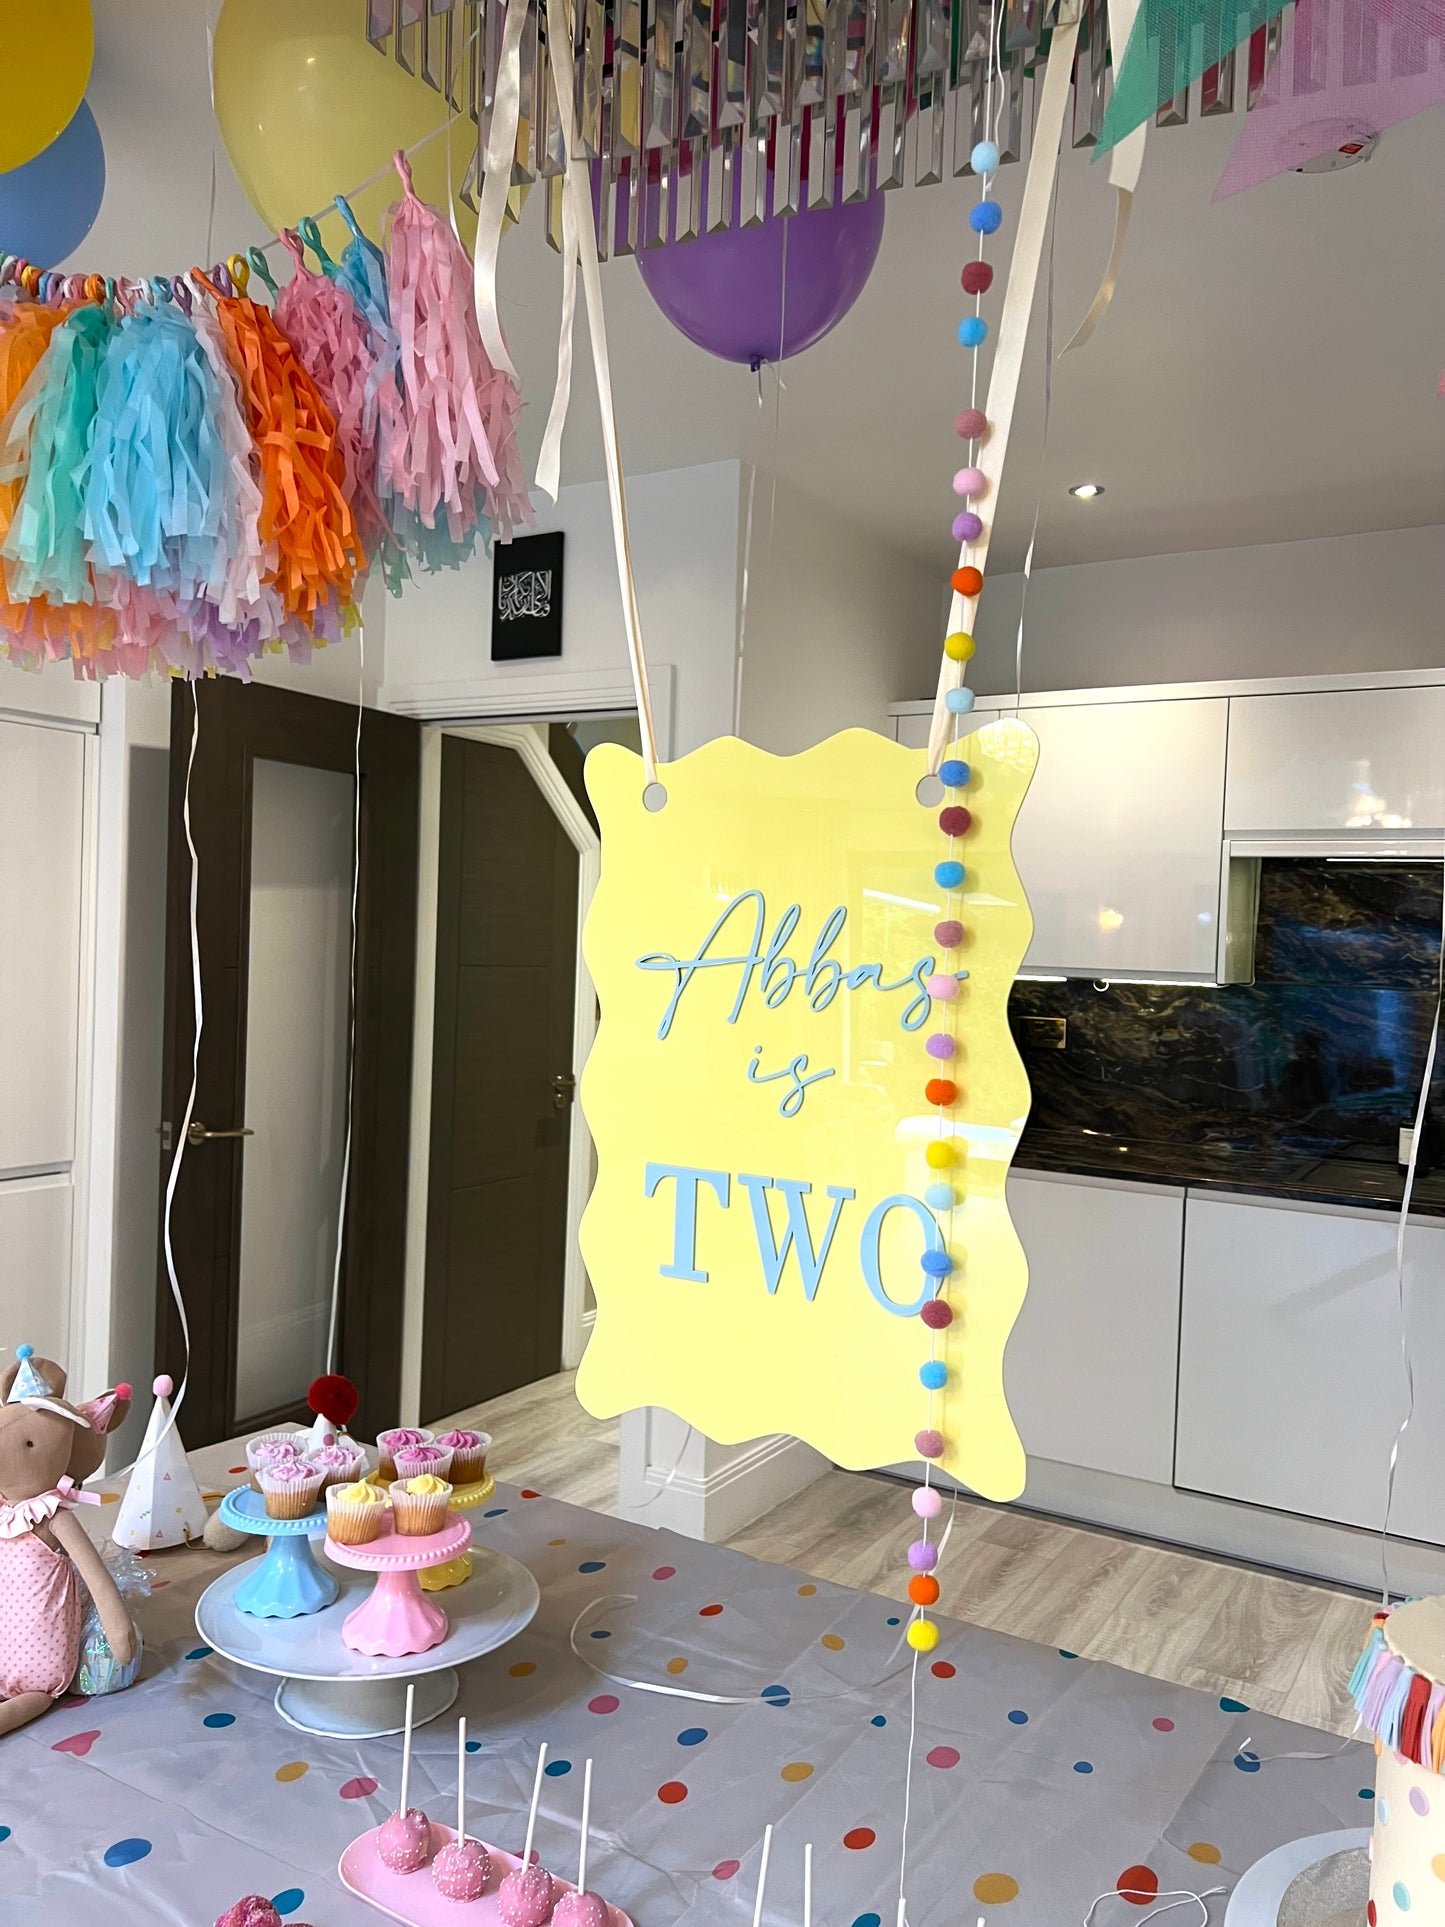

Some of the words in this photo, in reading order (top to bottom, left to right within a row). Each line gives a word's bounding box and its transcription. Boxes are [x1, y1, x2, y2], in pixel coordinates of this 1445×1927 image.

[636, 890, 969, 1040] Abbas
[748, 1045, 835, 1117] is
[645, 1163, 946, 1317] TWO
